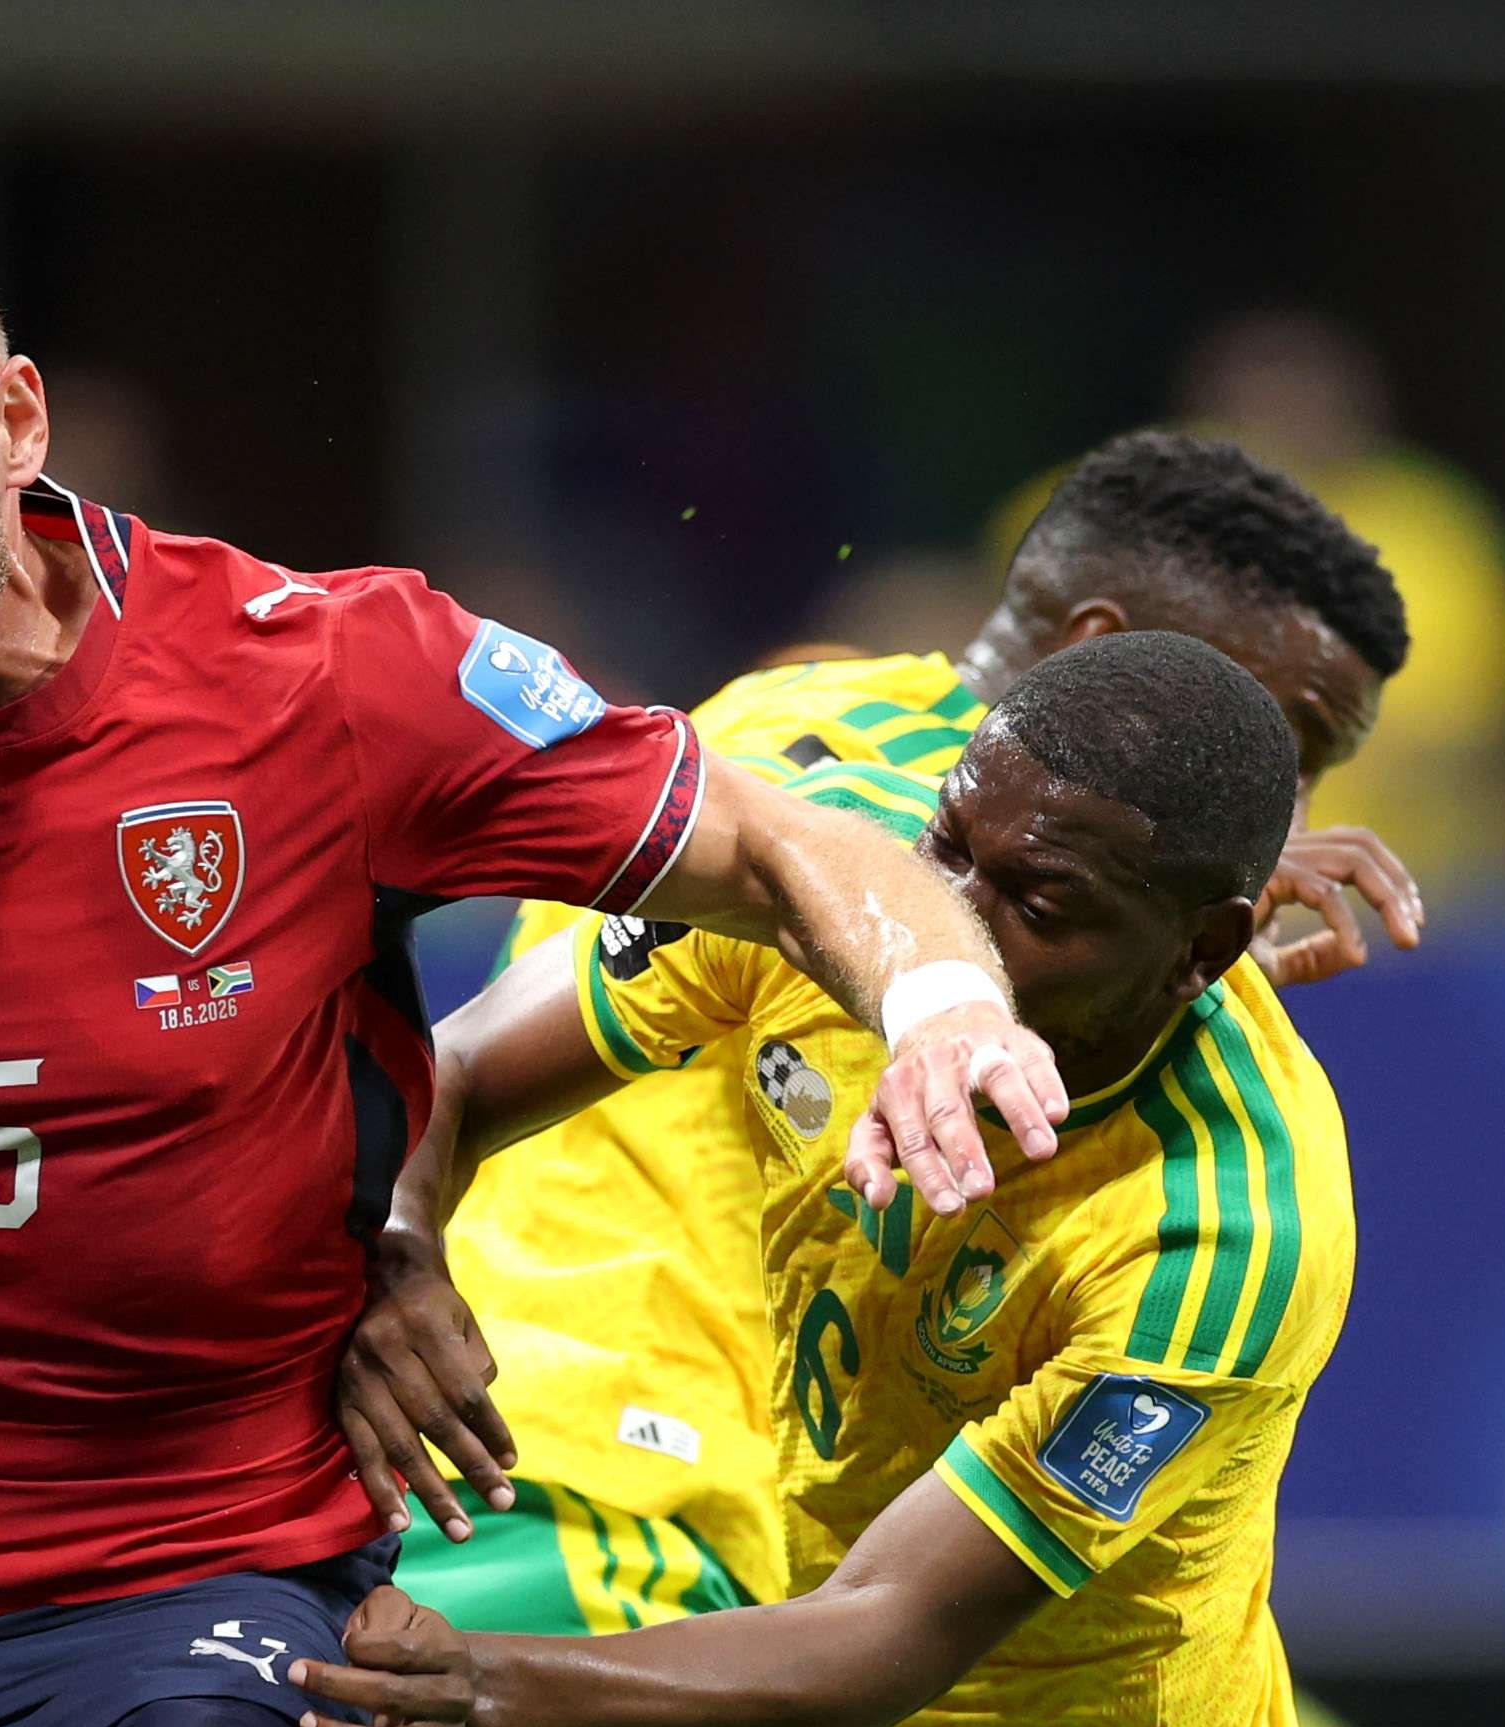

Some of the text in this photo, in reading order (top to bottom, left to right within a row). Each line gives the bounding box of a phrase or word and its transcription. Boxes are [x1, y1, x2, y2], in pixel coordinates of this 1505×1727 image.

[158, 997, 239, 1031] 18.6.2026
[793, 1287, 861, 1462] 6
[1093, 1418, 1134, 1455] Unite
[1079, 1468, 1110, 1497] FIFA
[1080, 1440, 1137, 1488] PEACE
